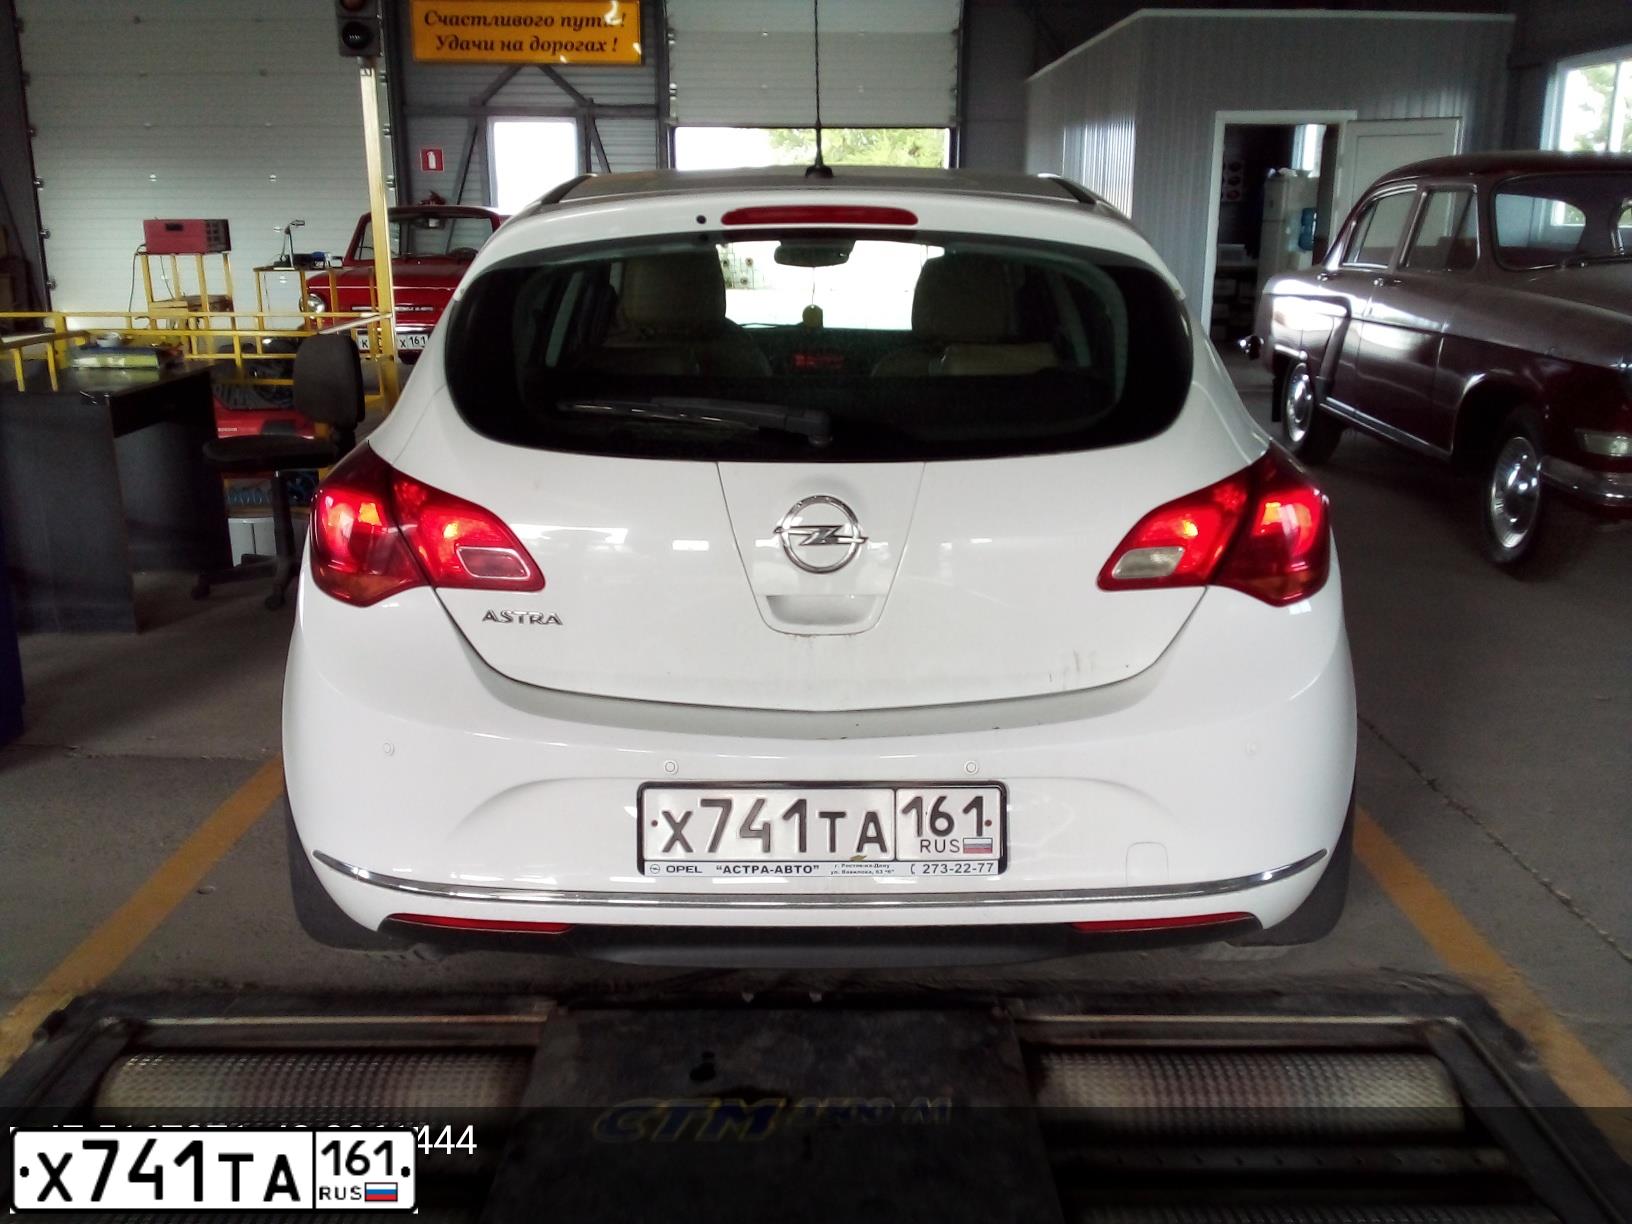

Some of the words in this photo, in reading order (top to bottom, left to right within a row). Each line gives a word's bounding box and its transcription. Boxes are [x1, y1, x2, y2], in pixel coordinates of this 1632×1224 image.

[424, 10, 555, 28] Счастливого
[435, 34, 495, 52] Удачи
[500, 39, 524, 52] на
[529, 34, 607, 56] дорогах
[482, 609, 563, 626] ASTRA
[661, 798, 888, 853] Х741ТА
[901, 795, 984, 838] 161
[919, 838, 961, 854] RUS
[665, 865, 703, 874] OPEL
[922, 862, 994, 875] 273-22-77
